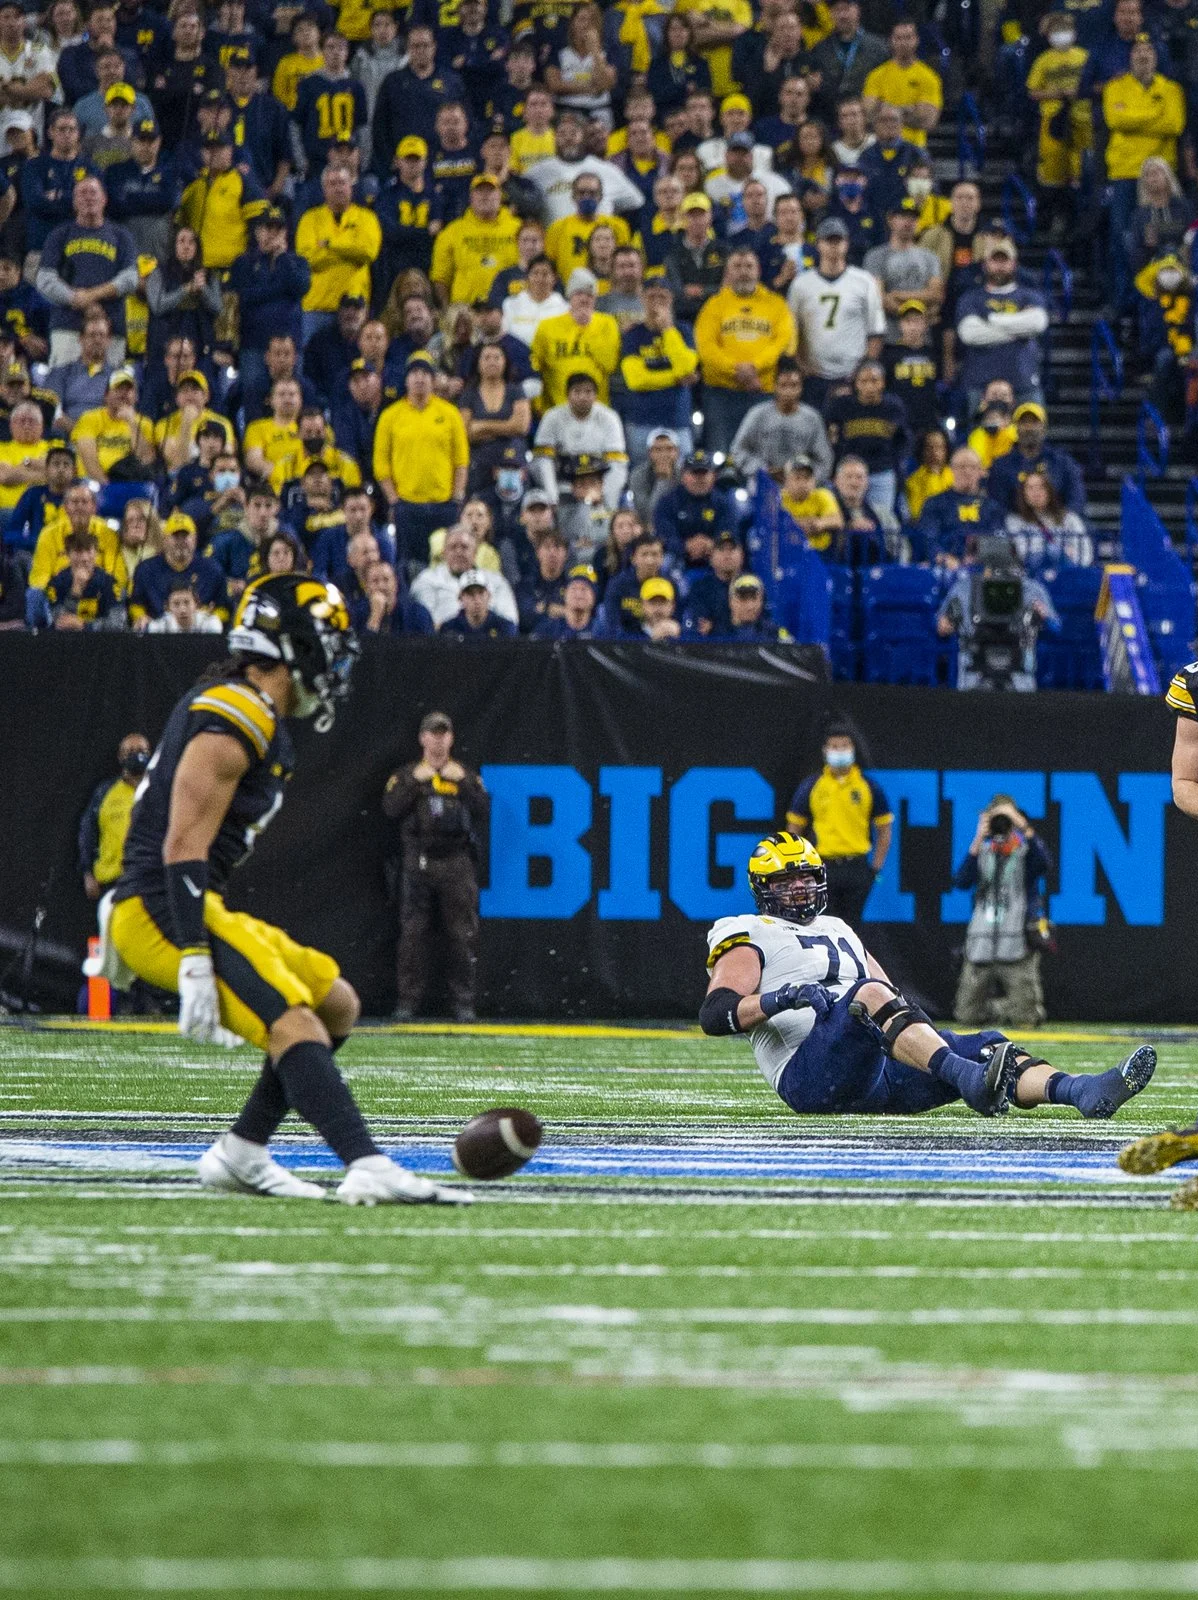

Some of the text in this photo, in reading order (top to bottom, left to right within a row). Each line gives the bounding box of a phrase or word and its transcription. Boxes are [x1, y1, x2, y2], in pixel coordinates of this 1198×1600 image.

[317, 93, 354, 139] 10
[820, 294, 840, 329] 7
[479, 764, 776, 921] BIG
[795, 934, 868, 987] 71
